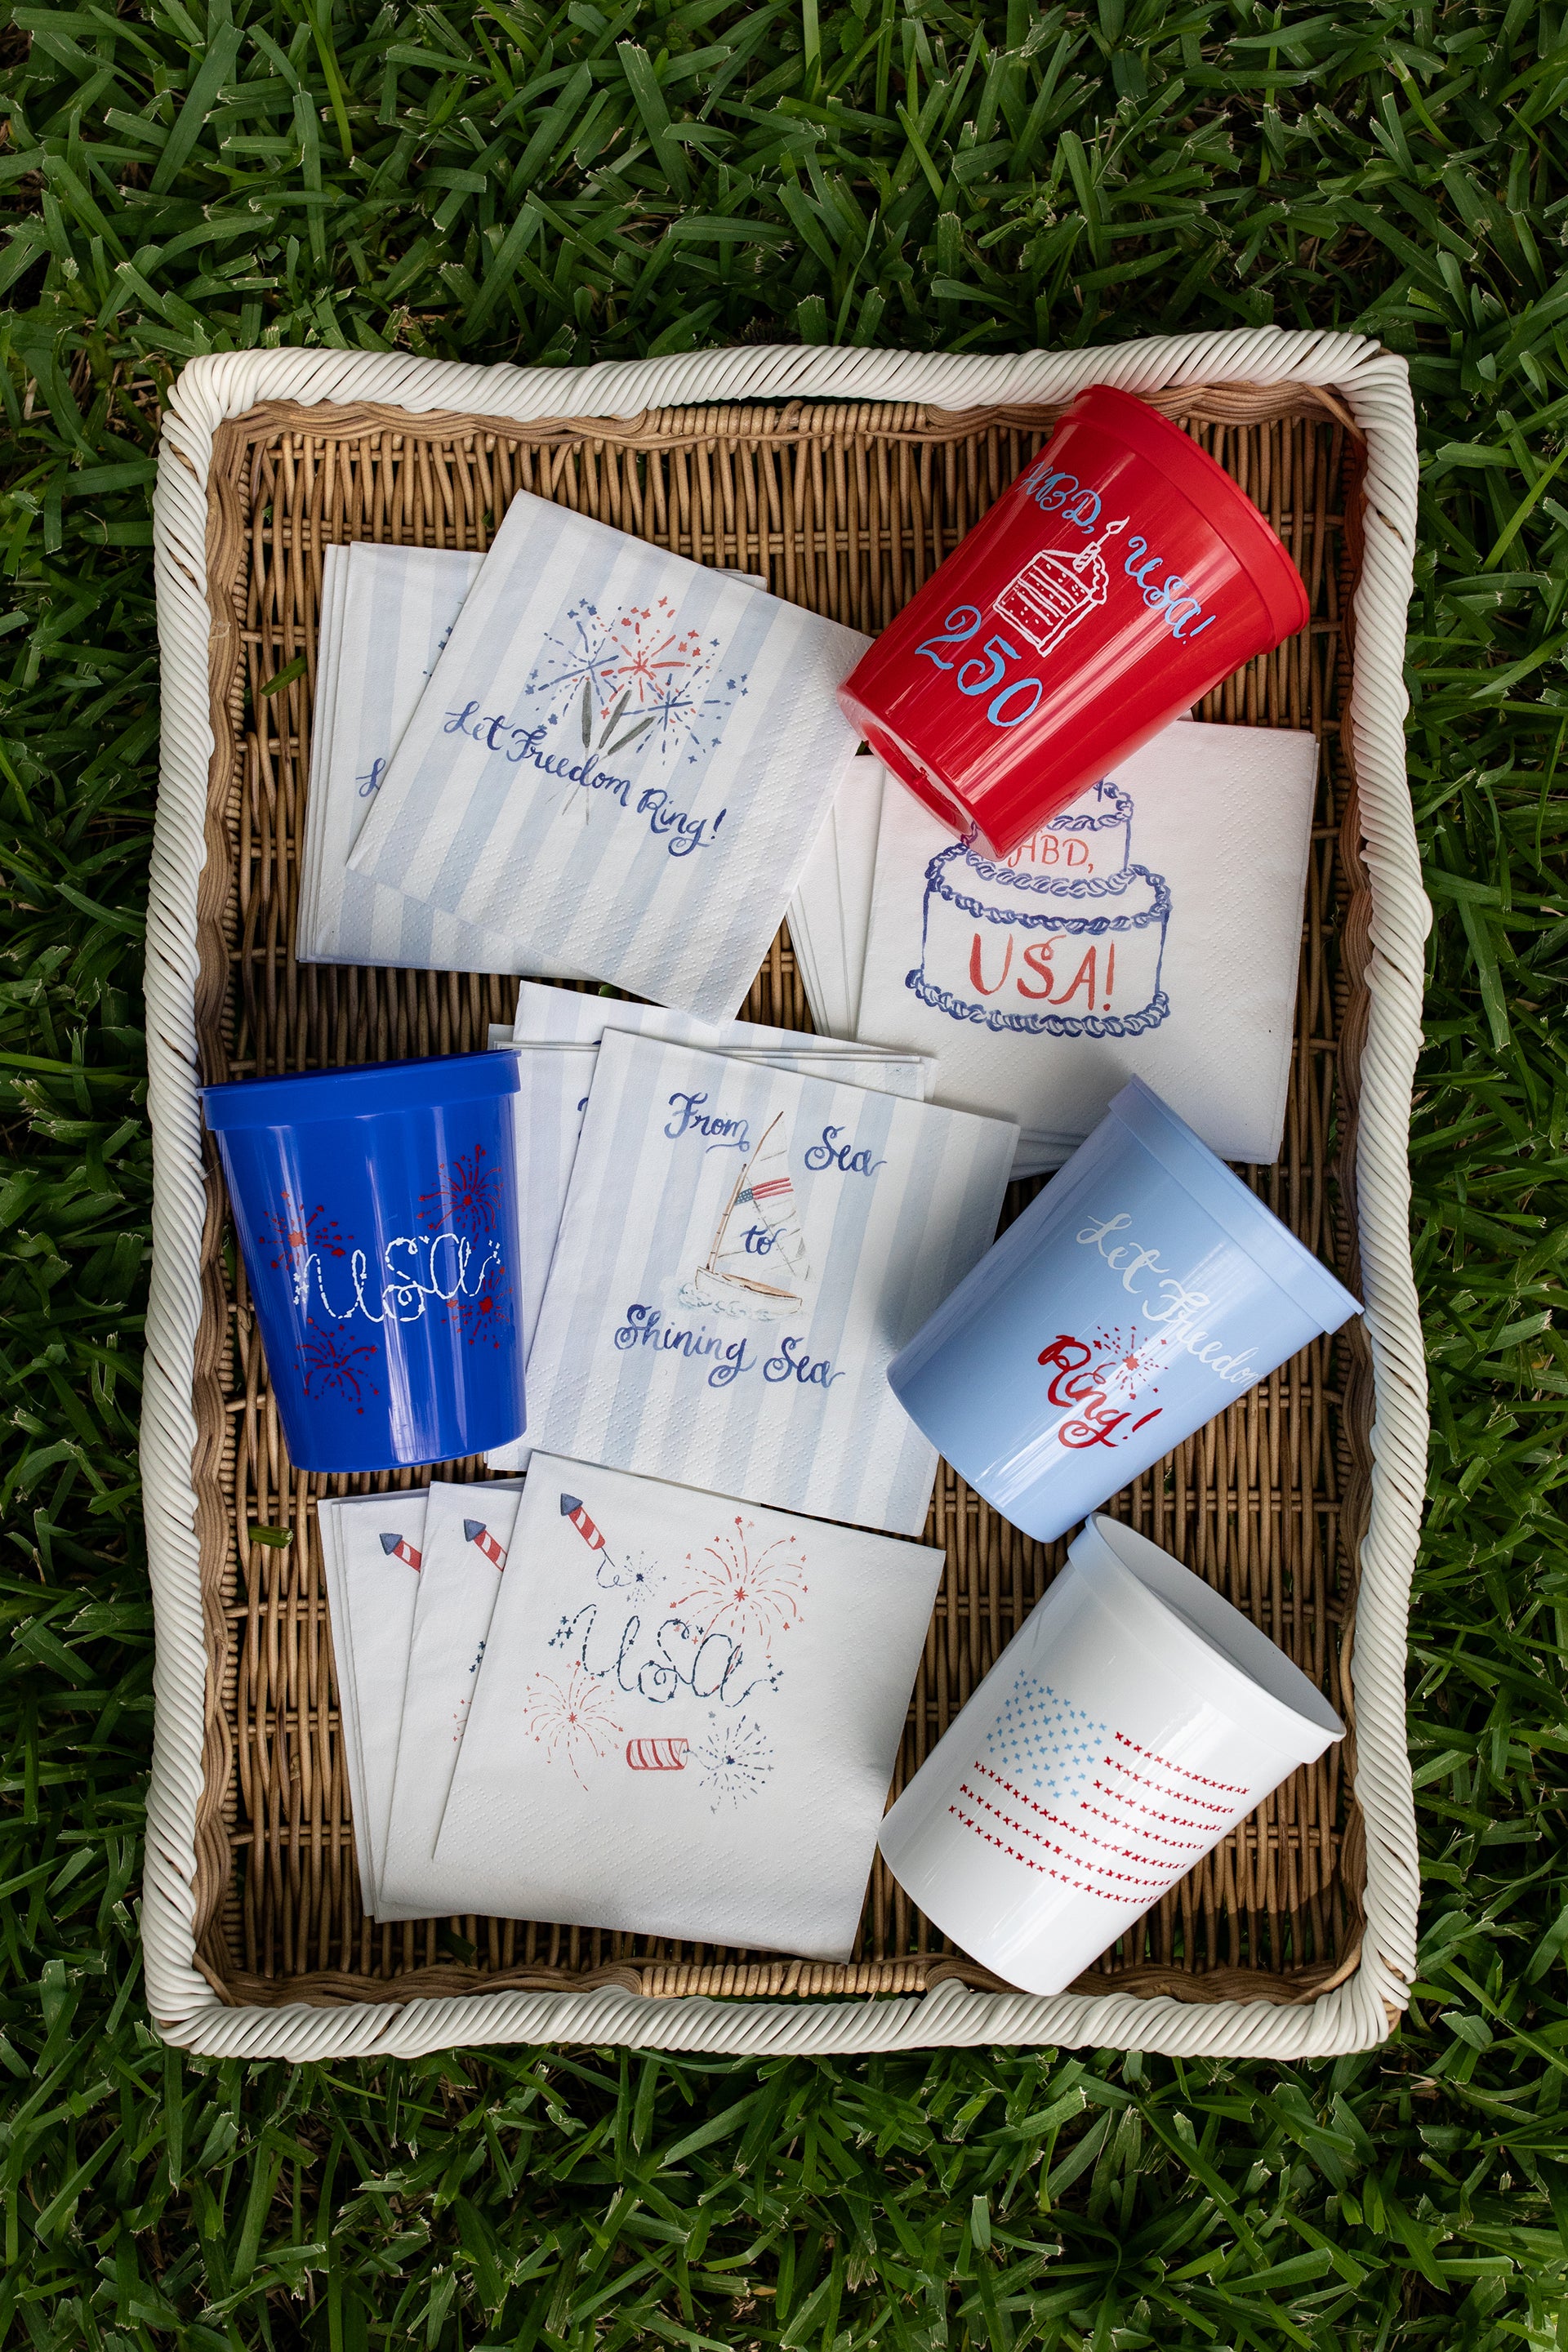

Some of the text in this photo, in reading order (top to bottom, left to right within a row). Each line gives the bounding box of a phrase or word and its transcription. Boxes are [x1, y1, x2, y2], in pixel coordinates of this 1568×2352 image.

[1014, 461, 1216, 645] HBD, USA!
[915, 604, 1043, 728] 250
[443, 700, 726, 858] Let Freedom Ring!
[1007, 833, 1094, 874] HBD,
[968, 932, 1116, 1012] USA!
[663, 1091, 888, 1177] From Sea
[303, 1232, 495, 1323] USA
[740, 1225, 787, 1257] to
[613, 1303, 846, 1389] Shining Sea
[1076, 1212, 1266, 1388] Let Freedom
[1037, 1334, 1163, 1449] Ring!
[572, 1603, 768, 1709] USA
